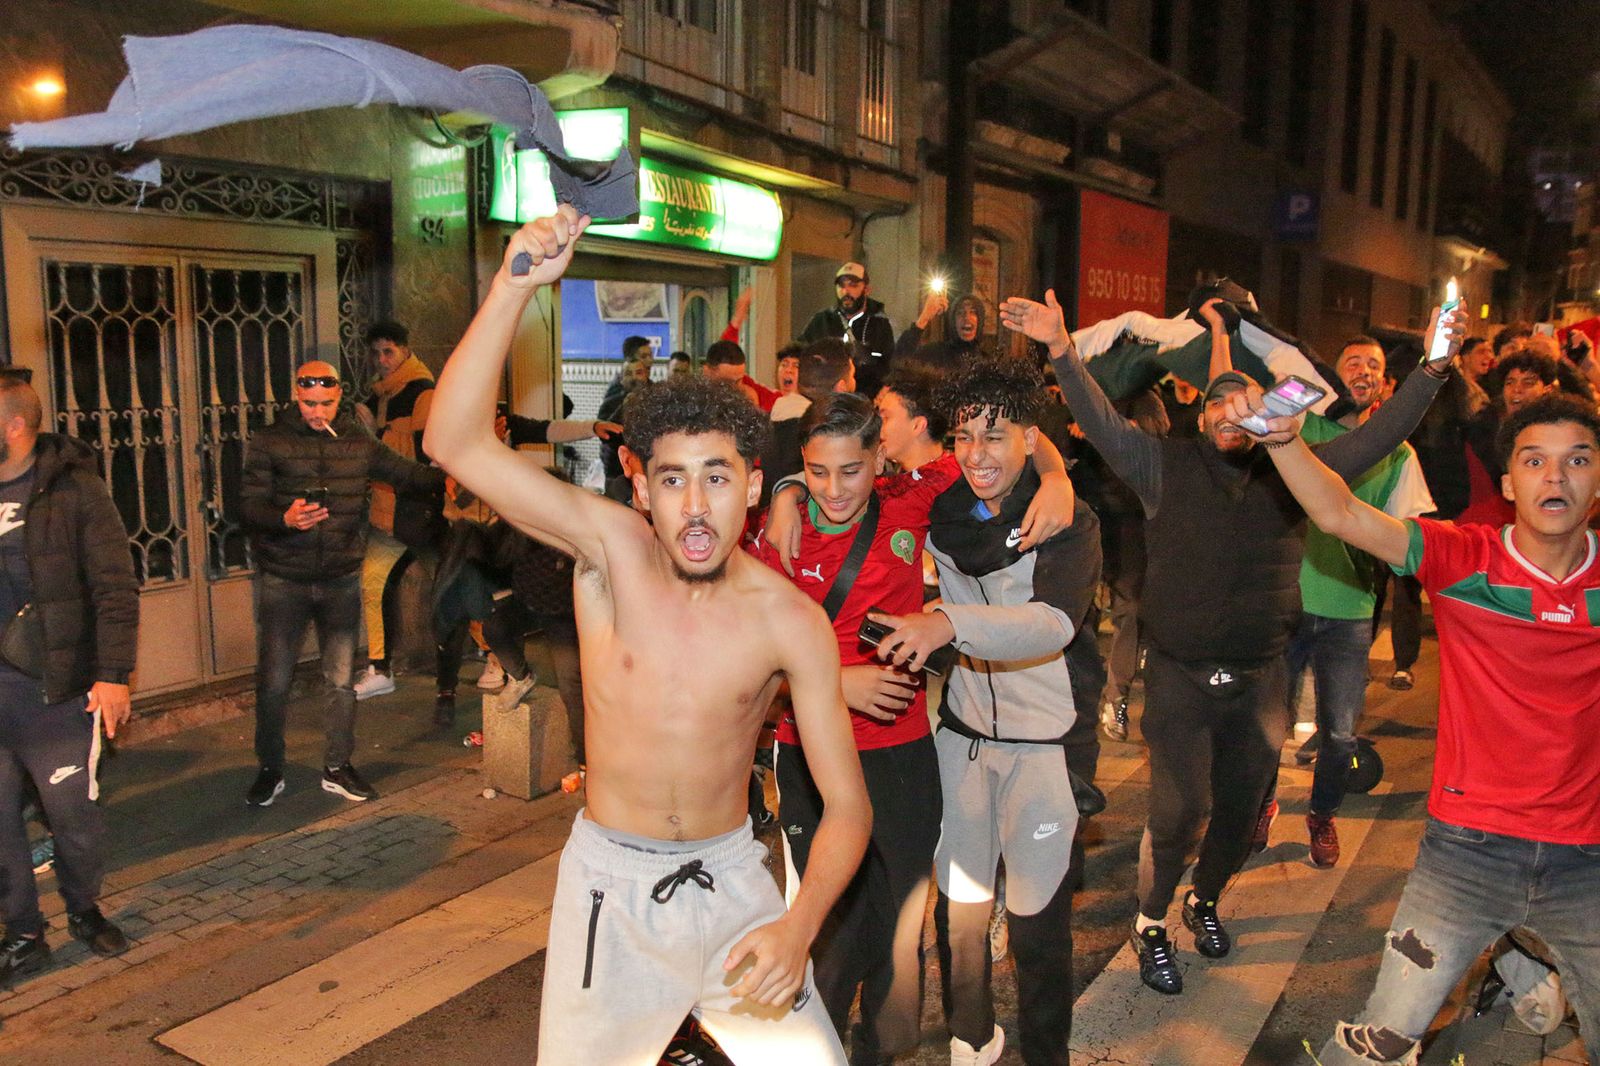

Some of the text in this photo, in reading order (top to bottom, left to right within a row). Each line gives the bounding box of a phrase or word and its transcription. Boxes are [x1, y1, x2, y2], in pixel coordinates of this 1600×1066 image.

[1087, 267, 1114, 299] 950
[1116, 271, 1130, 301] 10
[1541, 611, 1571, 623] PUMA
[1038, 822, 1059, 832] NIKE
